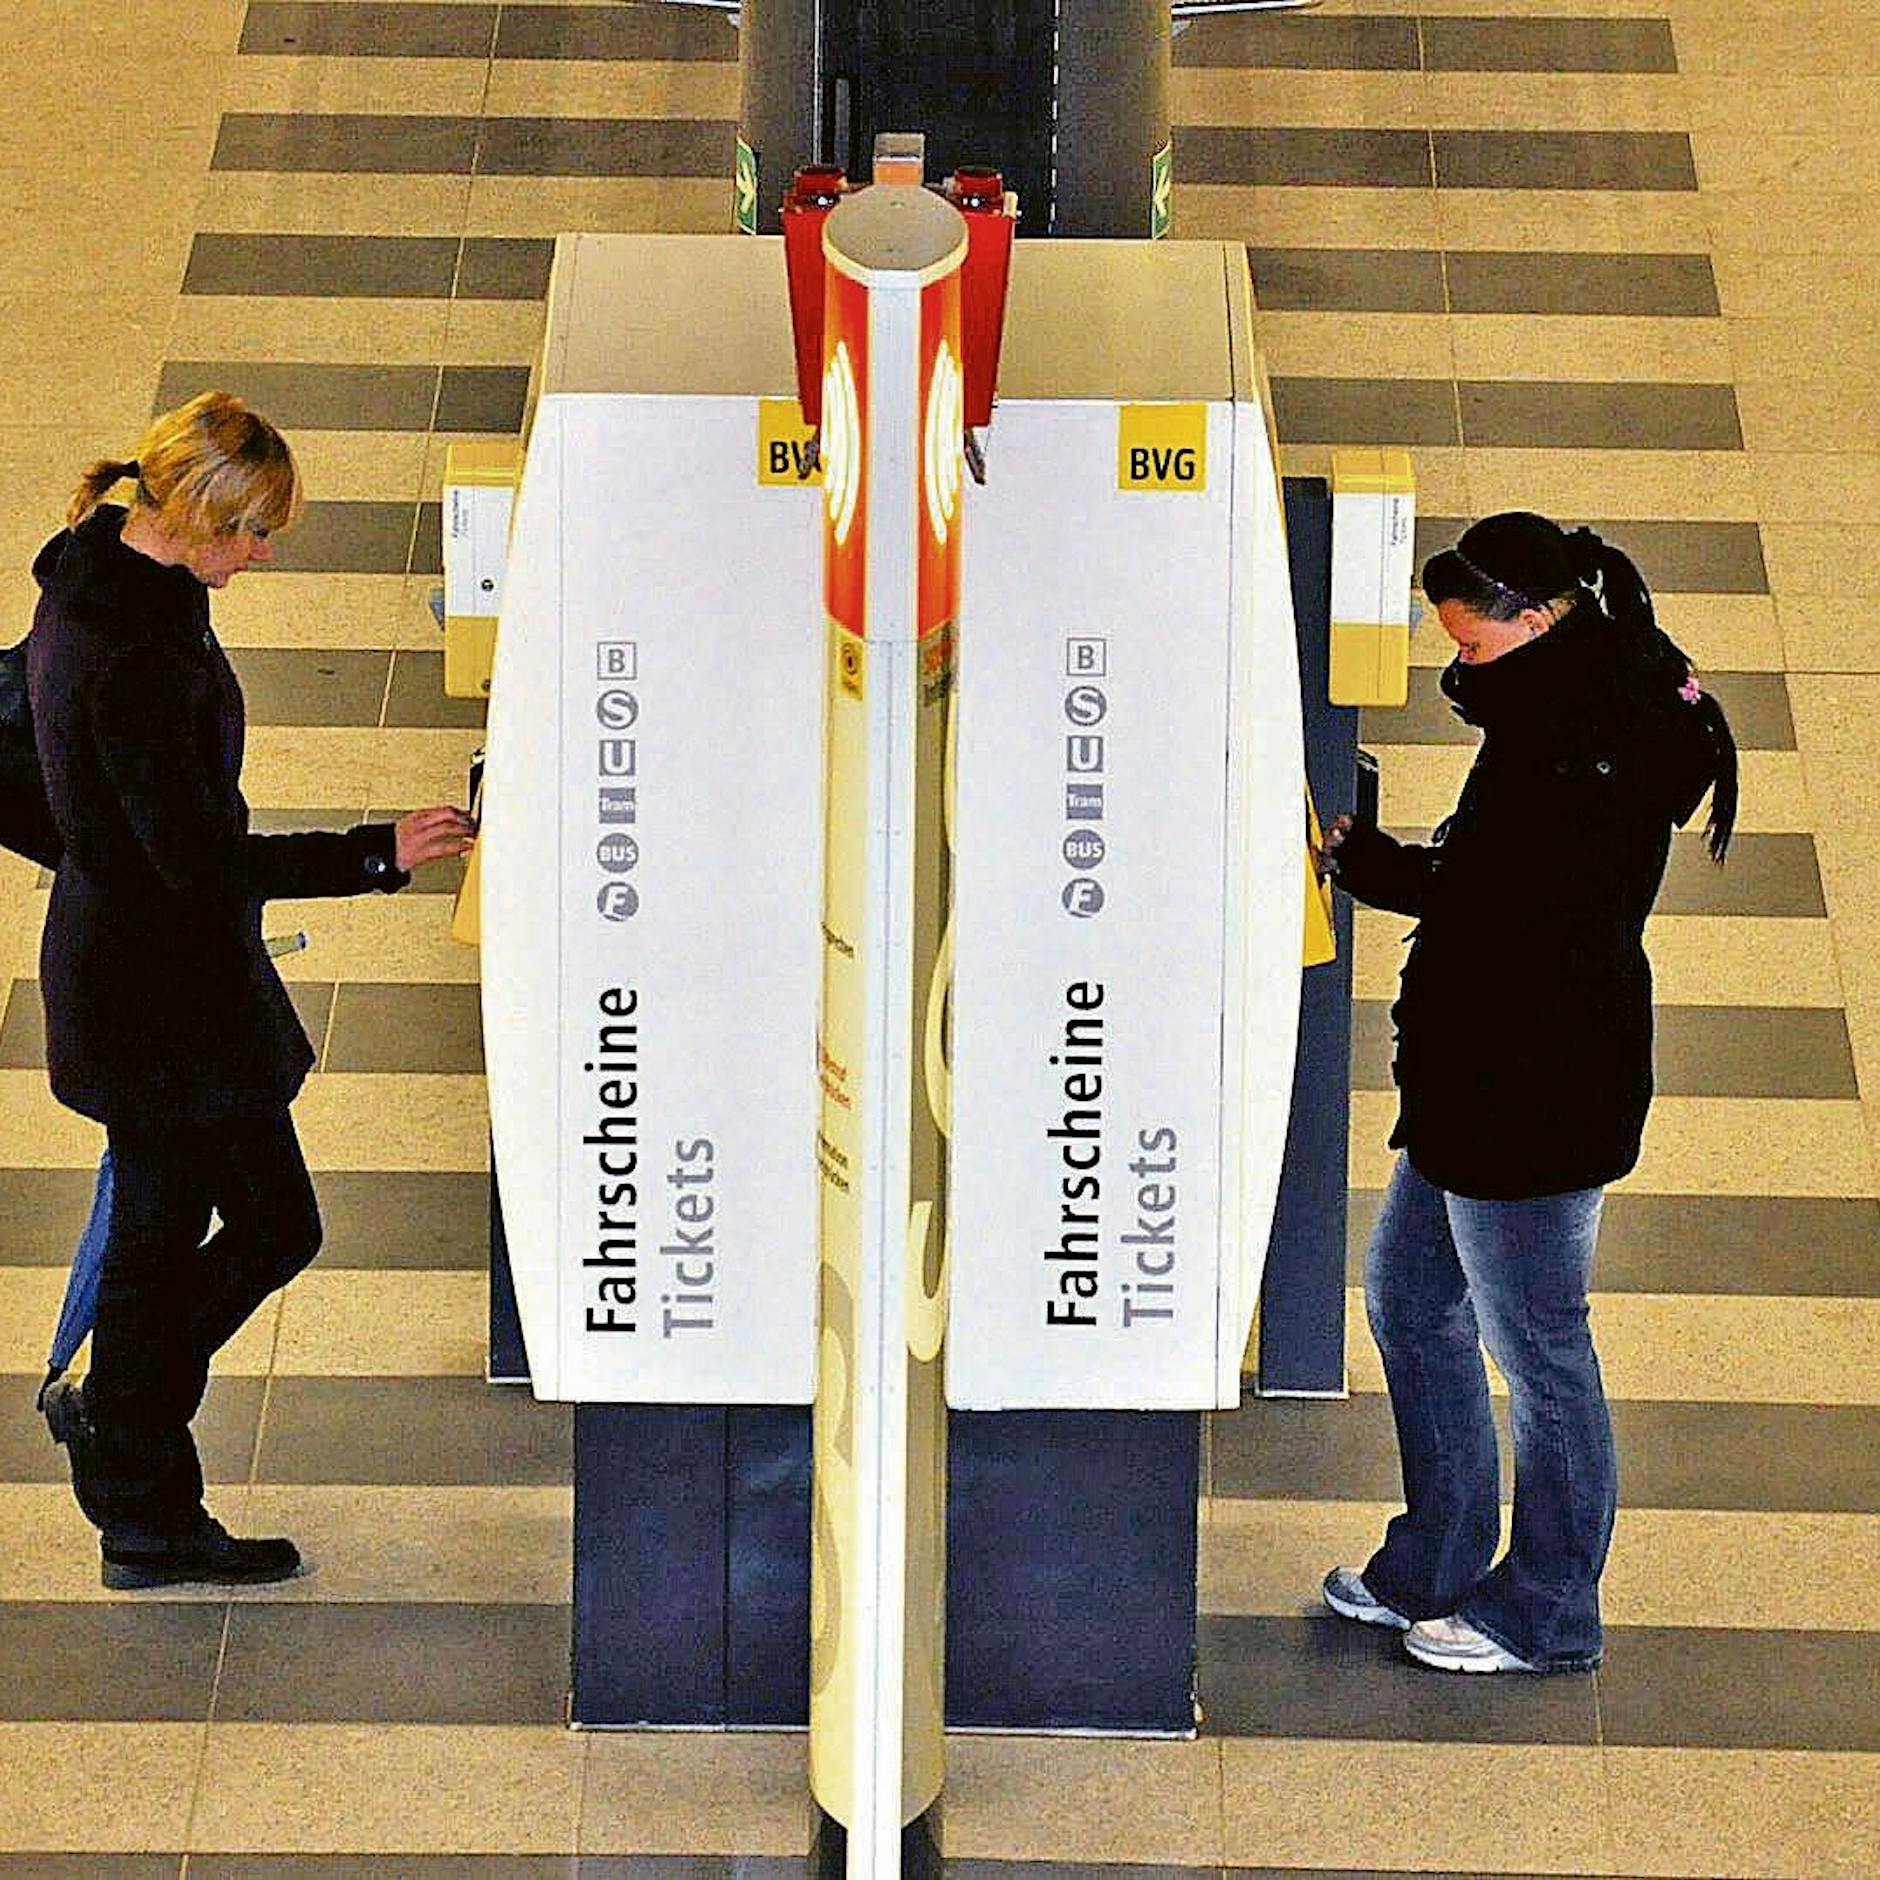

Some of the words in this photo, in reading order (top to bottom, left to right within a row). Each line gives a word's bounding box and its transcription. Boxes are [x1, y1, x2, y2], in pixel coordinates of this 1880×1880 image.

[771, 441, 821, 474] BV
[1131, 448, 1195, 481] BVG
[608, 649, 625, 673] B
[1078, 645, 1094, 670] B
[598, 690, 638, 729] S
[1066, 687, 1106, 725] S
[602, 740, 634, 774] U
[1070, 737, 1100, 771] U
[597, 845, 638, 862] BUS
[1065, 842, 1104, 859] BUS
[583, 987, 638, 1333] Fahrscheine
[1044, 981, 1104, 1327] Fahrscheine
[660, 1138, 714, 1338] Tickets
[1120, 1127, 1177, 1328] Tickets
